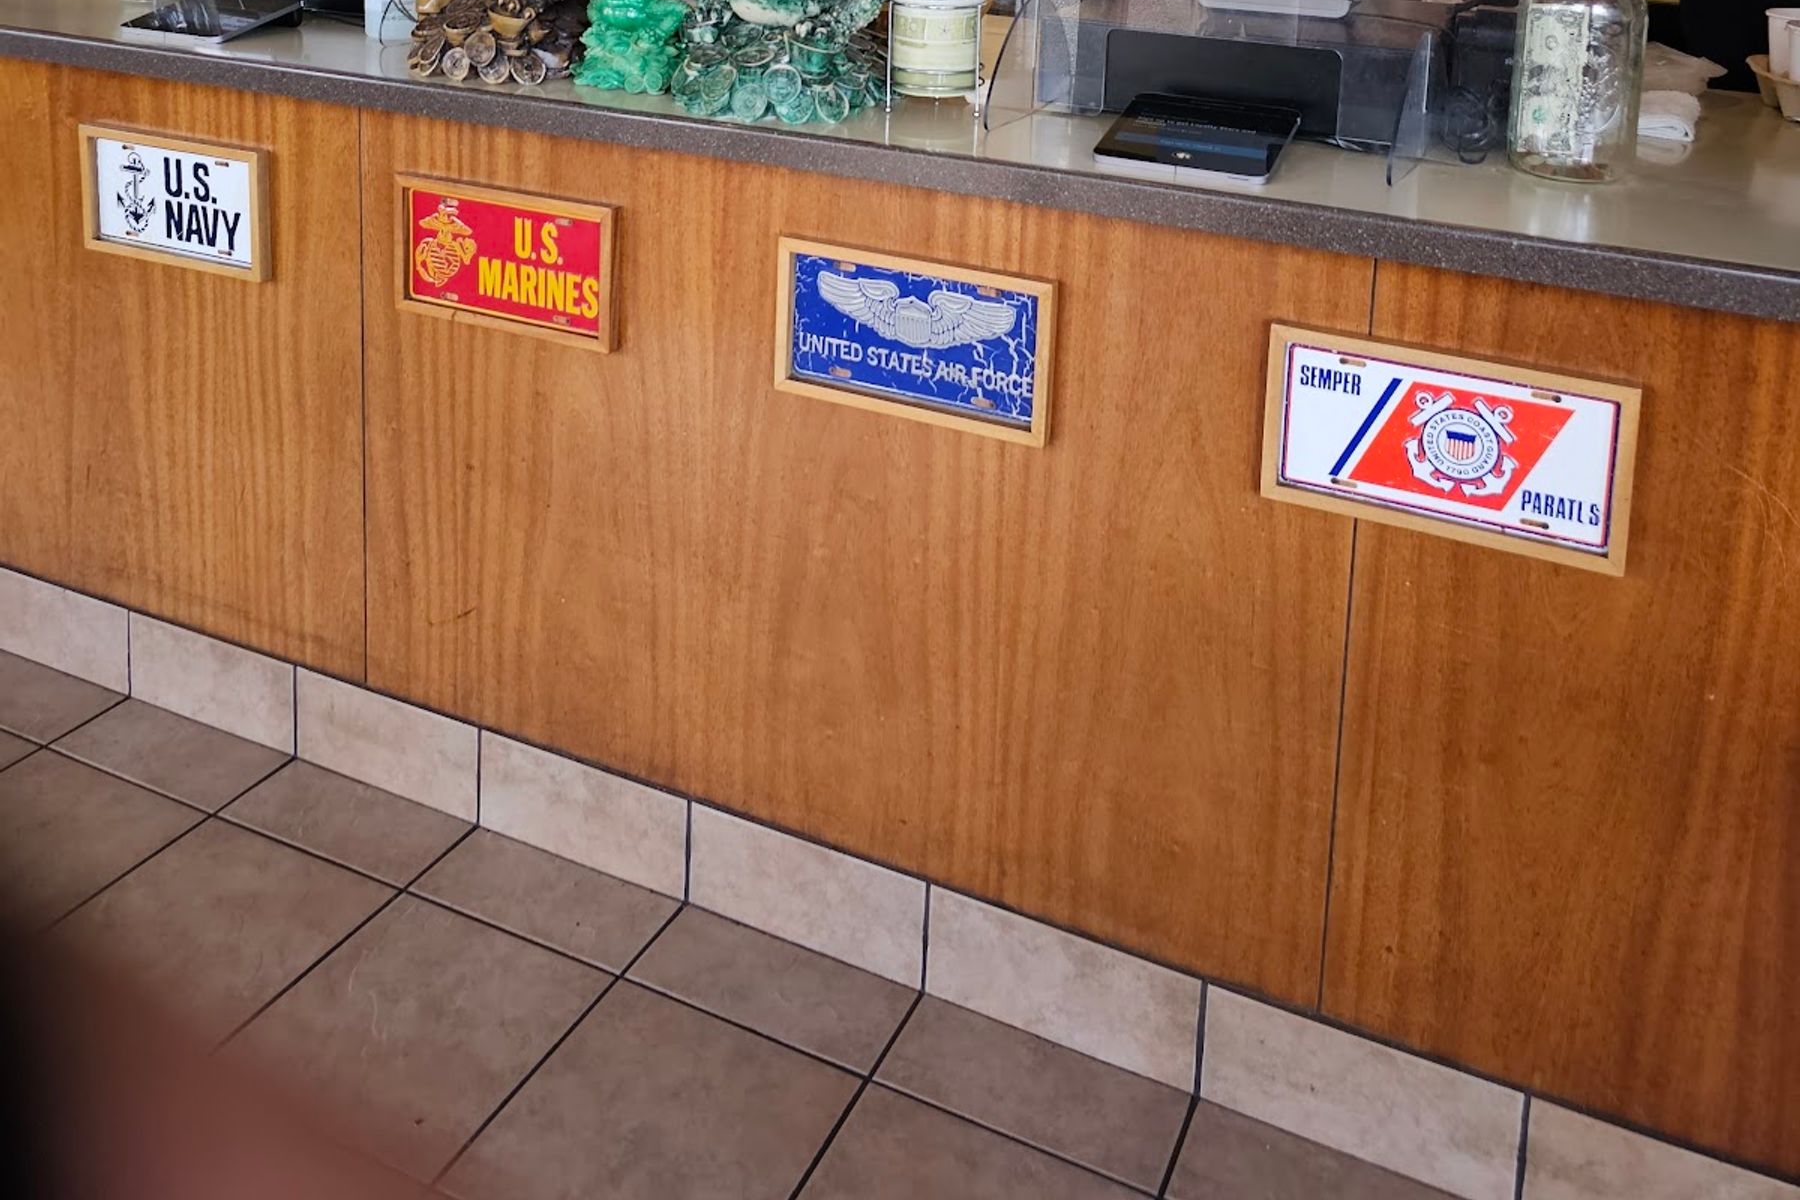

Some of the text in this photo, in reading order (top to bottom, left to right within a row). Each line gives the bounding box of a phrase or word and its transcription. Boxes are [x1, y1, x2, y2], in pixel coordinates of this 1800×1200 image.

[164, 157, 217, 204] U.S.
[165, 200, 241, 251] NAVY
[514, 216, 563, 265] U.S.
[478, 256, 599, 319] MARINES
[799, 331, 1033, 398] UNITED STATES AIR FORCE
[1300, 364, 1361, 397] SEMPER
[1430, 413, 1464, 430] STATES
[1467, 416, 1494, 443] COAST
[1427, 431, 1444, 466] UNITED
[1471, 445, 1494, 473] GUARD
